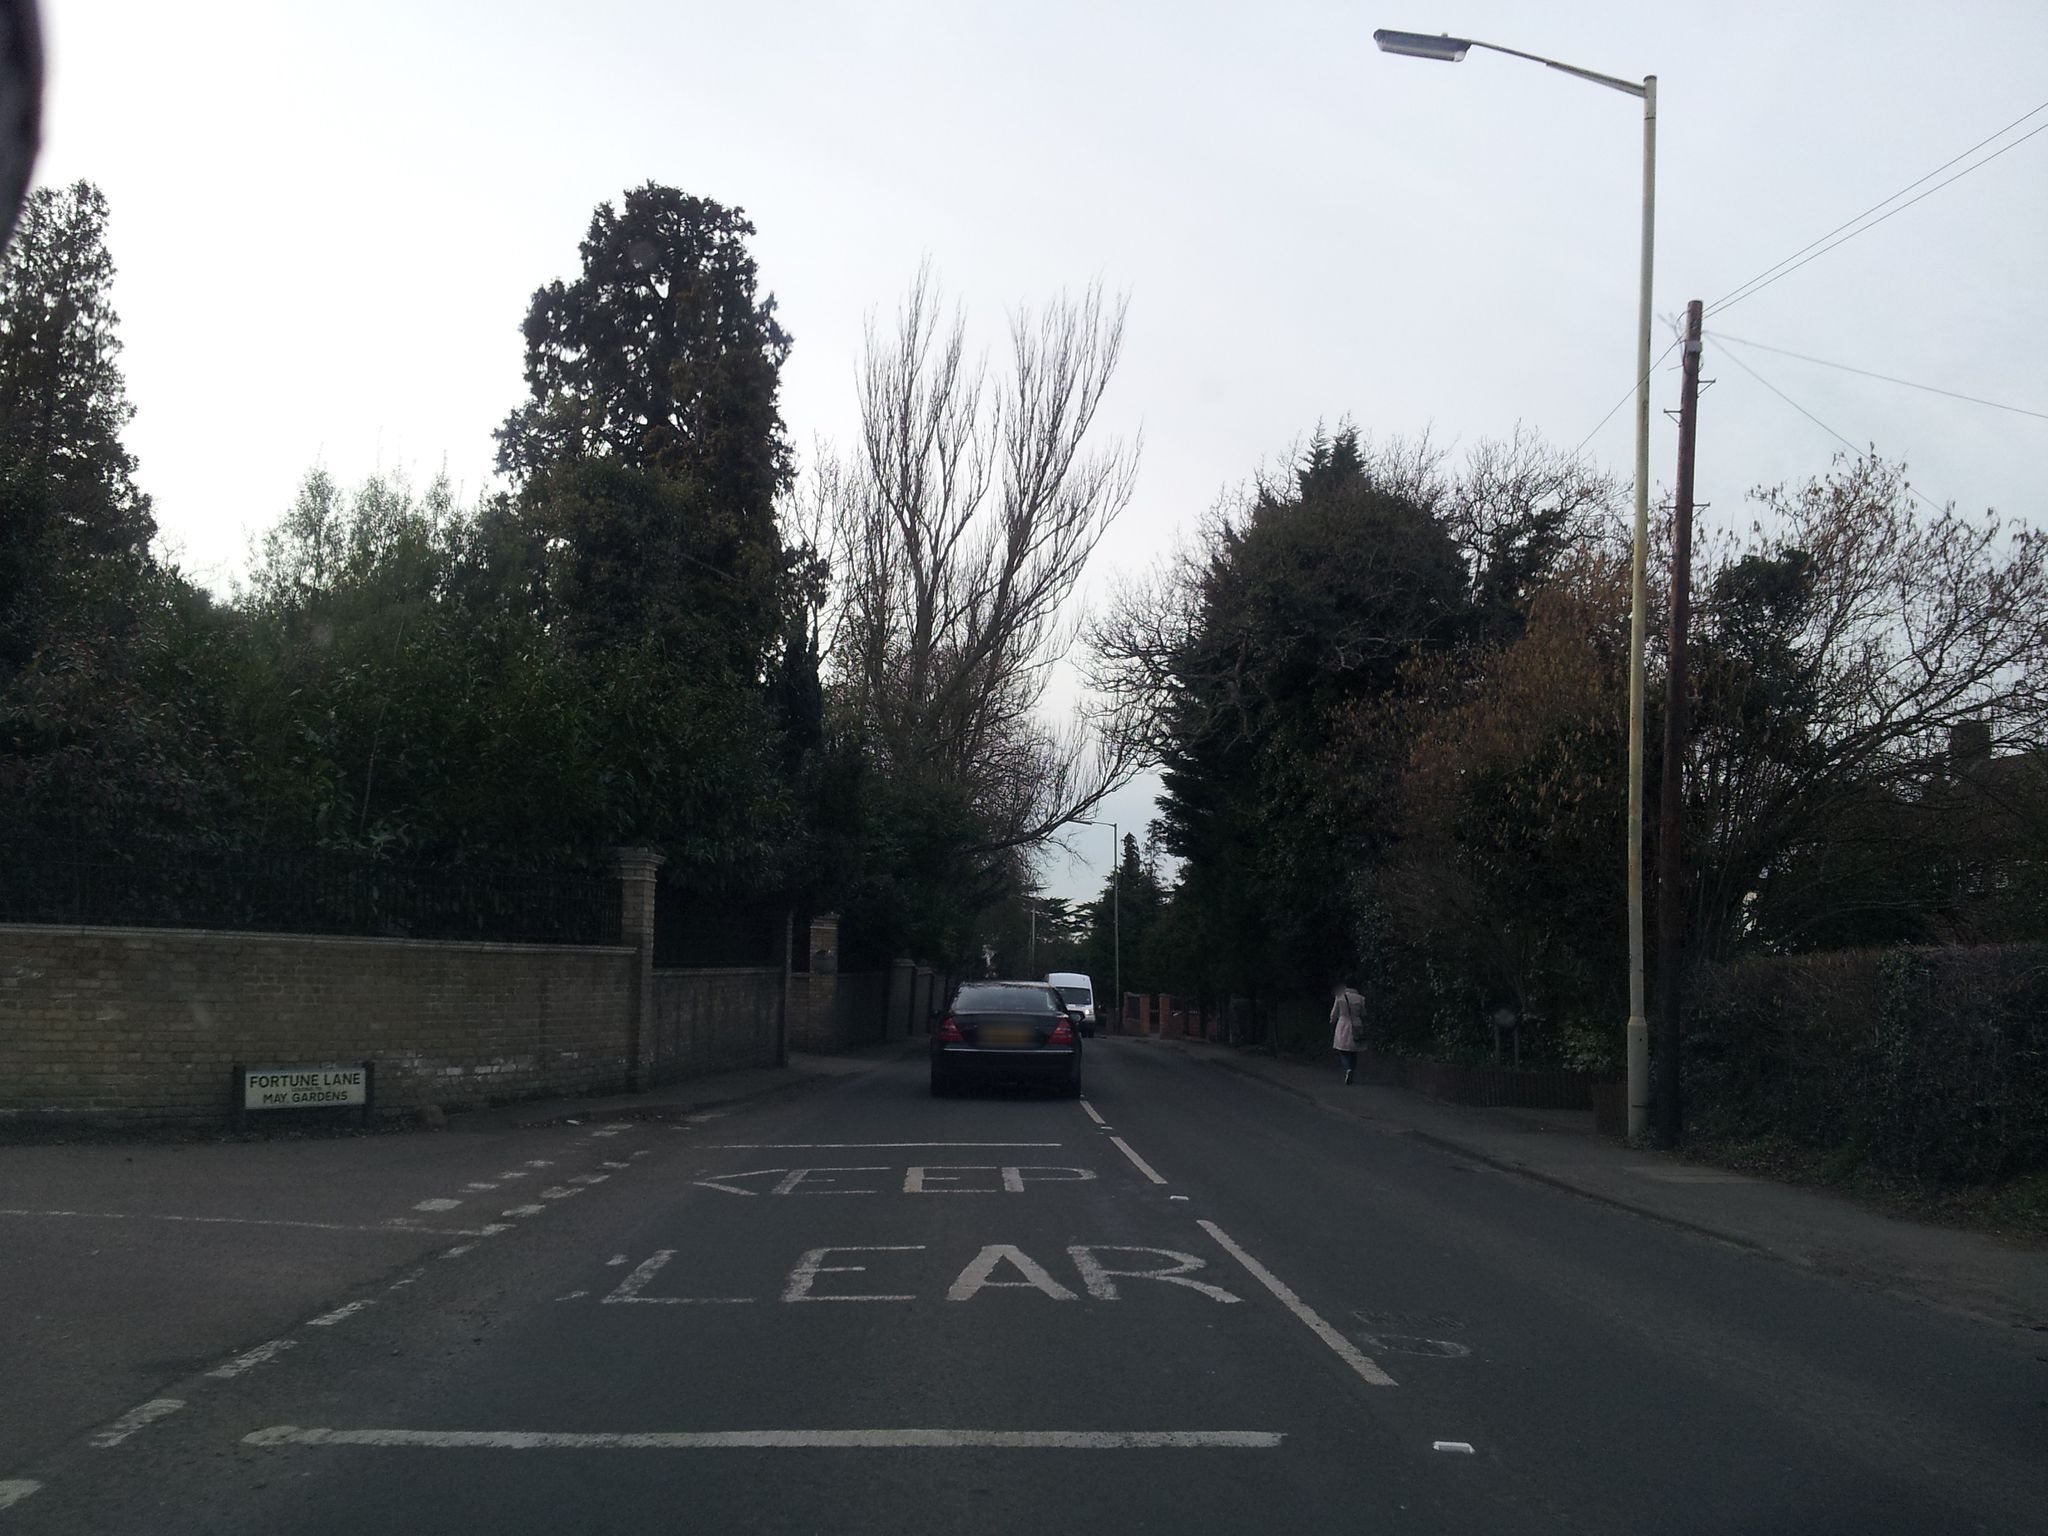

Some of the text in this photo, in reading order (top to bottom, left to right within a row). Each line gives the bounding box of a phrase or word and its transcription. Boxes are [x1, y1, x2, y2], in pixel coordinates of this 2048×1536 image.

[250, 1073, 361, 1088] FORTUNE LANE
[263, 1091, 348, 1104] MAY GARDENS
